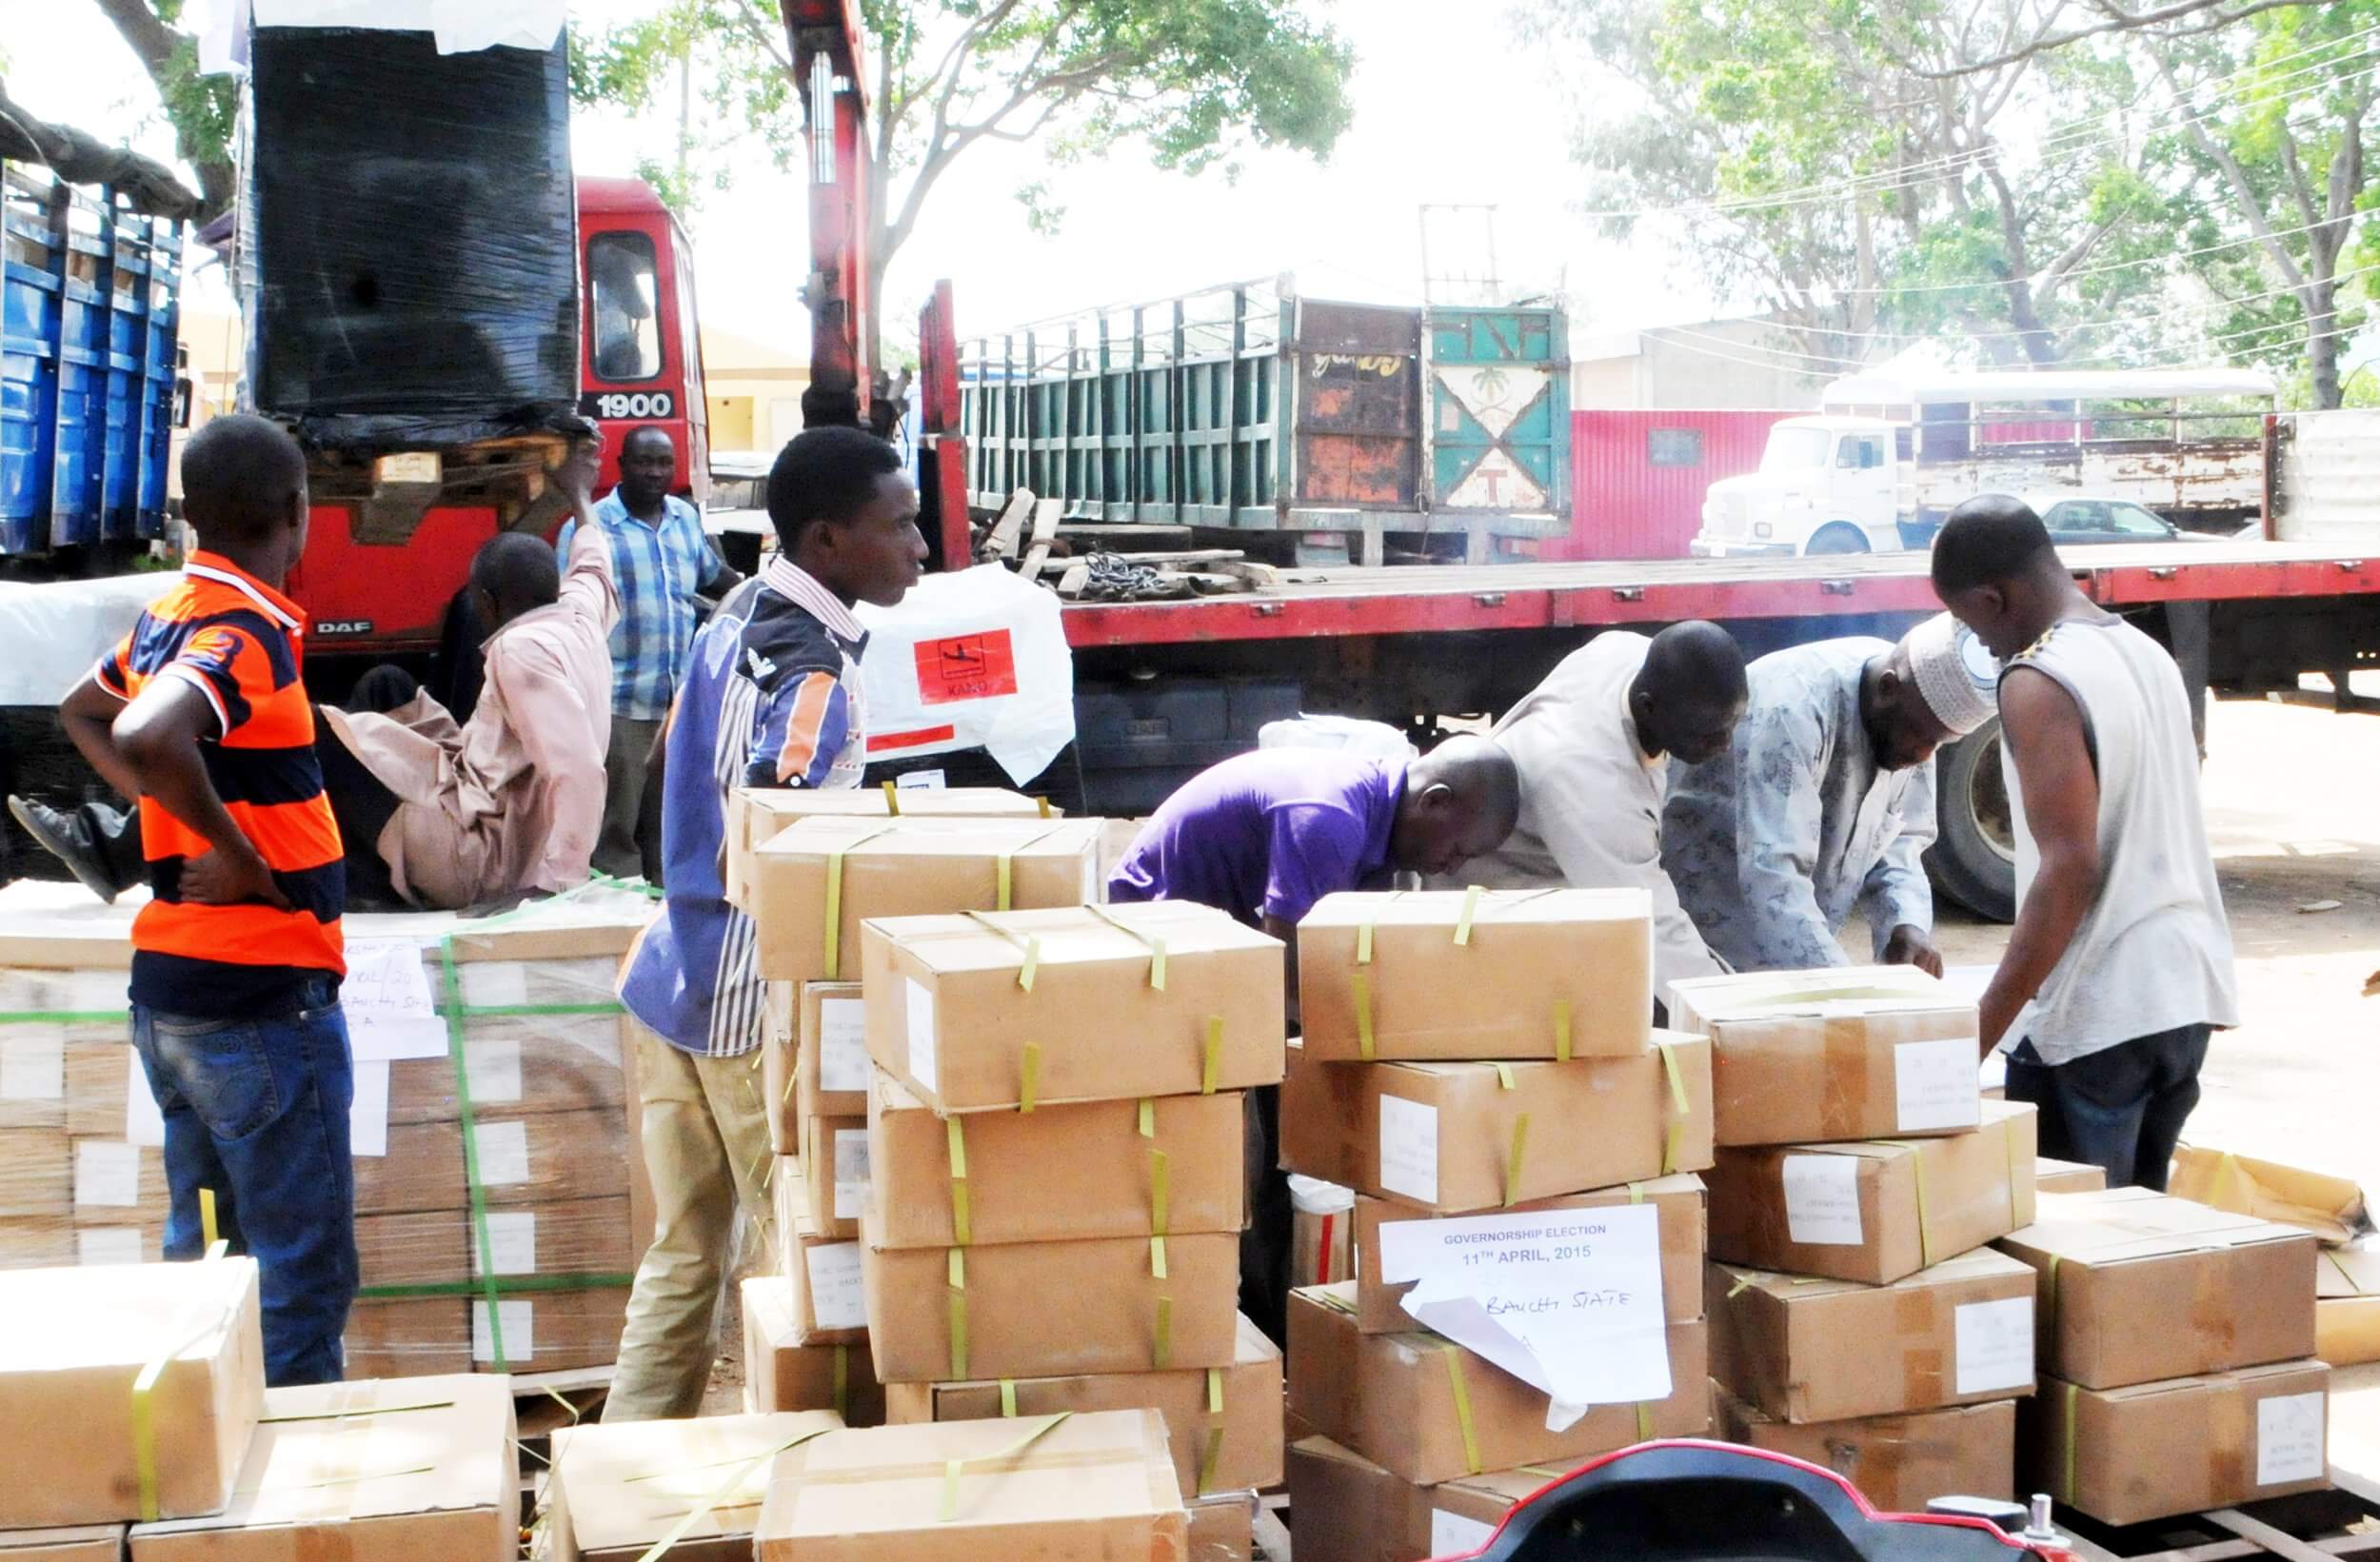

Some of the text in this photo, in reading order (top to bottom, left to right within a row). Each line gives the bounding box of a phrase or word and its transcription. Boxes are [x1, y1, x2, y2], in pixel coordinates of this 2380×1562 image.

[597, 394, 671, 417] 1900
[318, 622, 370, 632] DAF
[1444, 1224, 1607, 1245] GOVERNORSHIP ELECTION
[1462, 1244, 1592, 1266] 11TH APRIL, 2015
[1572, 1289, 1631, 1309] STATE
